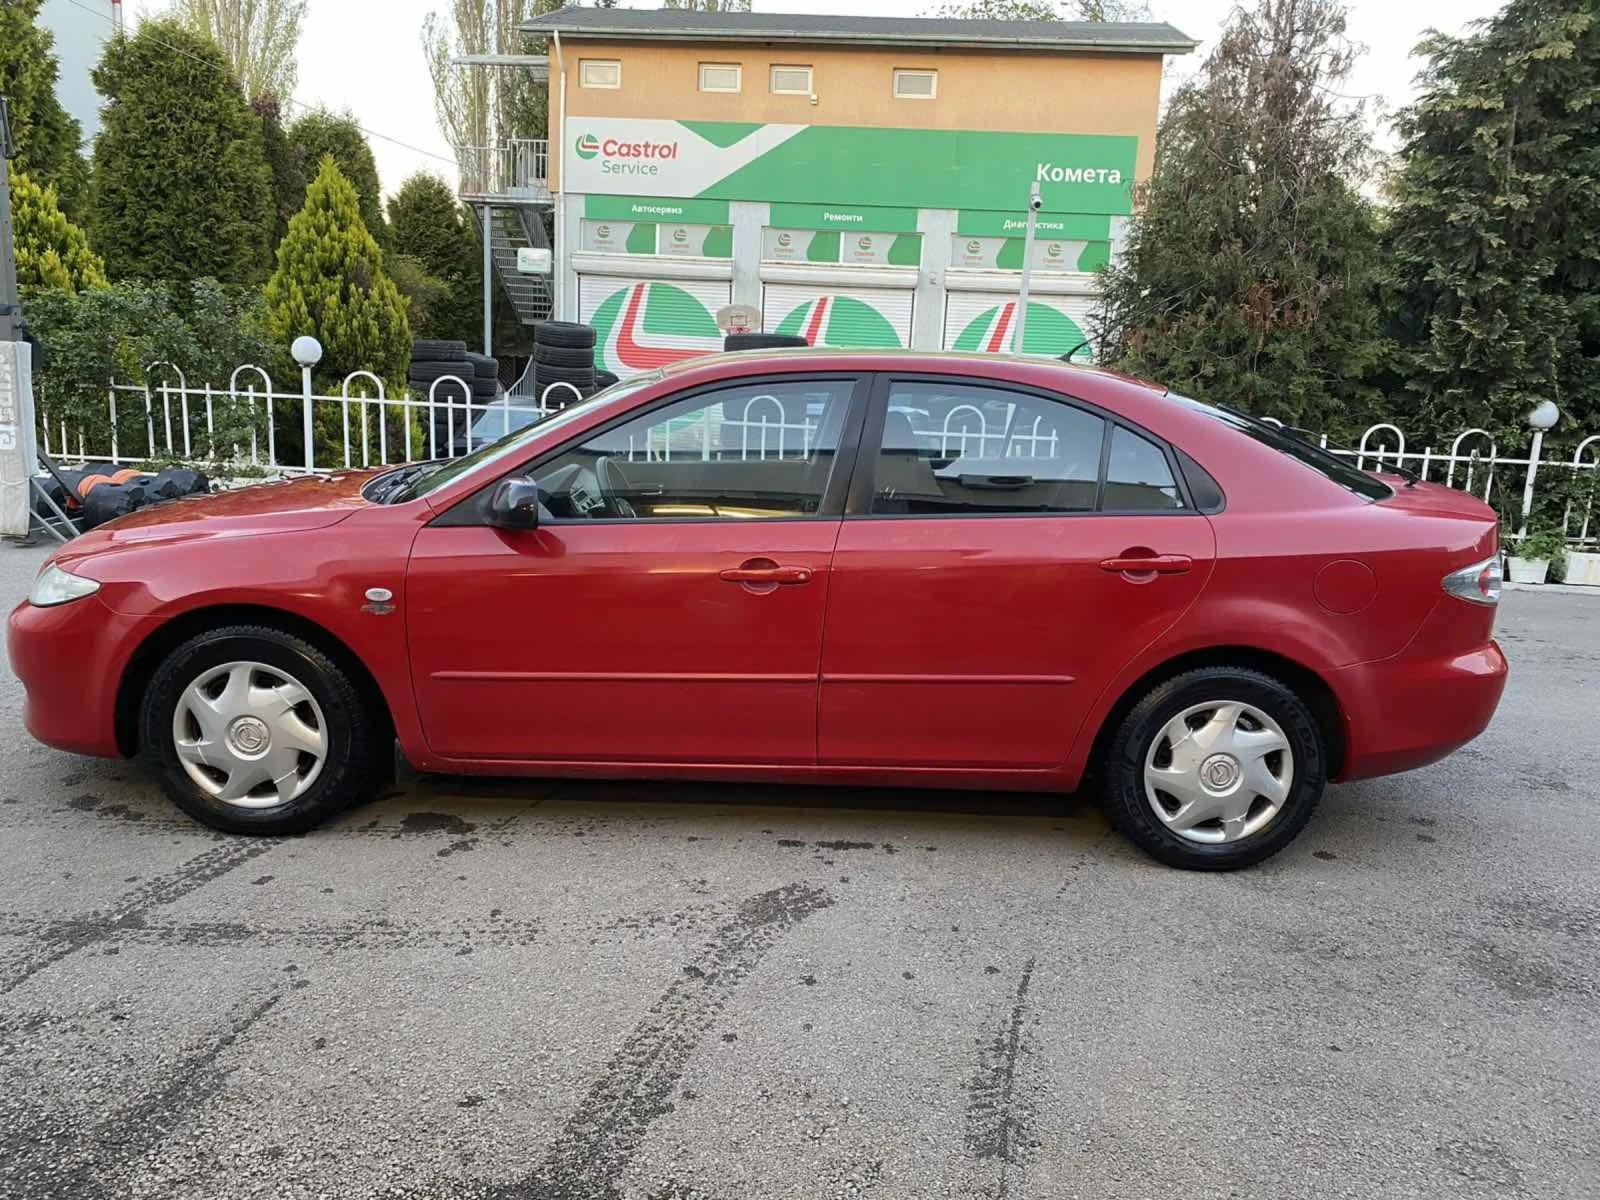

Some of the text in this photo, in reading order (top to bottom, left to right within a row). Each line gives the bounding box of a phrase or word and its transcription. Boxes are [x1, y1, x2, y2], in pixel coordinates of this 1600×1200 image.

[603, 139, 677, 159] Castrol
[602, 160, 658, 175] Service
[1037, 163, 1120, 184] Комета
[631, 204, 683, 215] Автосервиз
[1003, 219, 1064, 230] Диагстика
